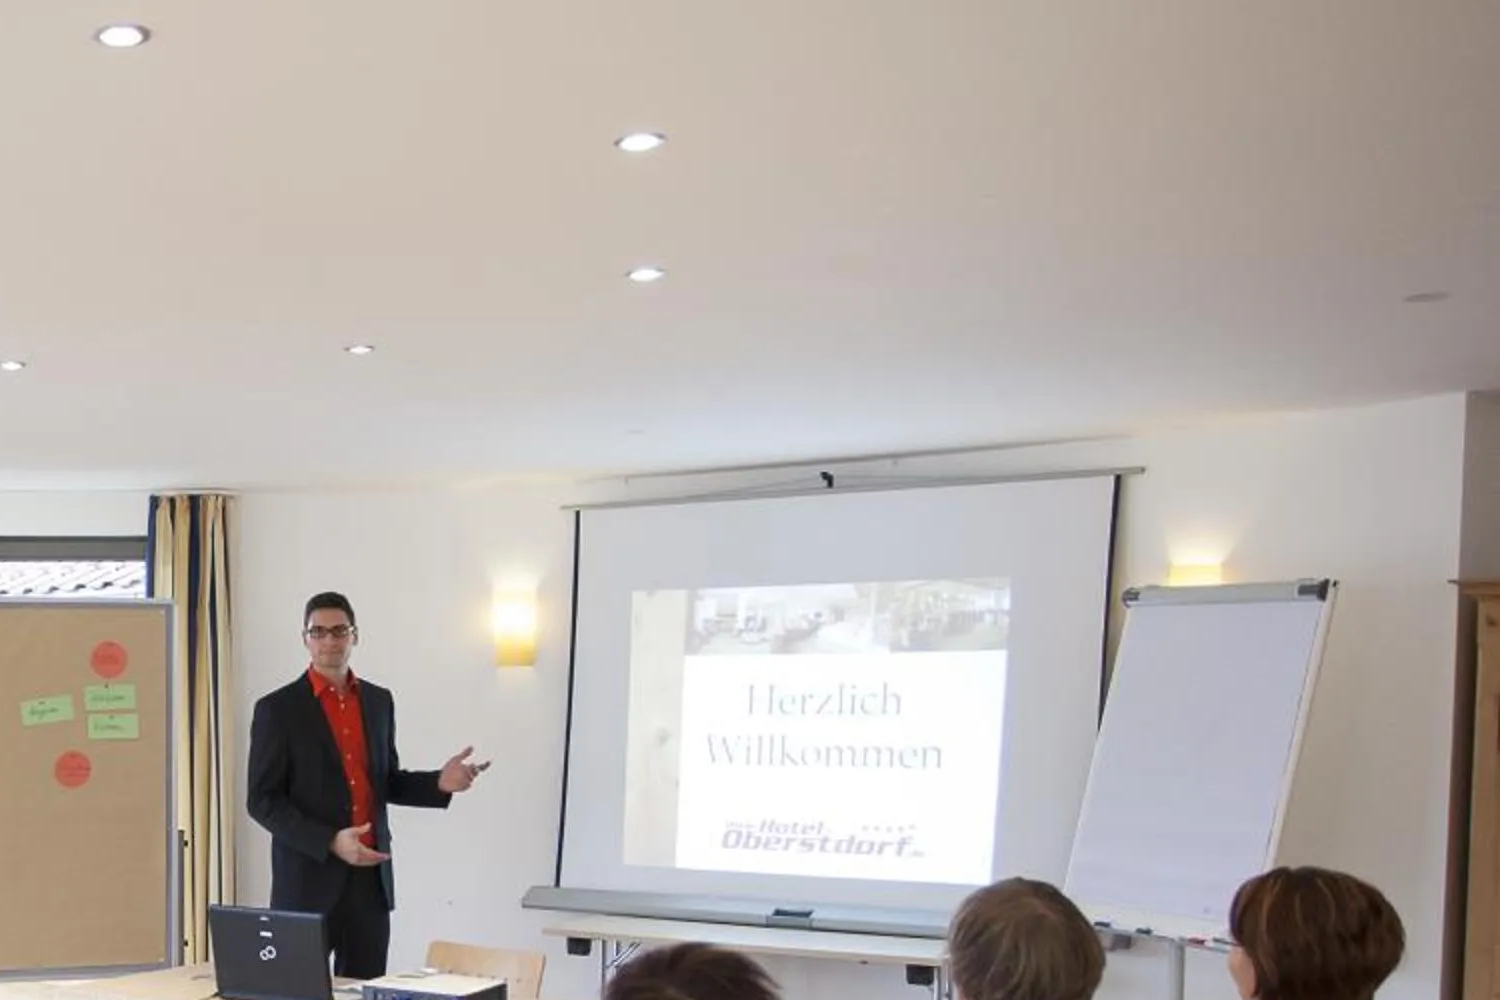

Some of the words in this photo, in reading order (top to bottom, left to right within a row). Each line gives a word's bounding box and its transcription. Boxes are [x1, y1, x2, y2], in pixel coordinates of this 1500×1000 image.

[747, 682, 902, 716] Herzlich
[706, 733, 942, 769] Willkommen
[721, 829, 911, 857] Oberstdorf
[759, 820, 824, 835] Hotel
